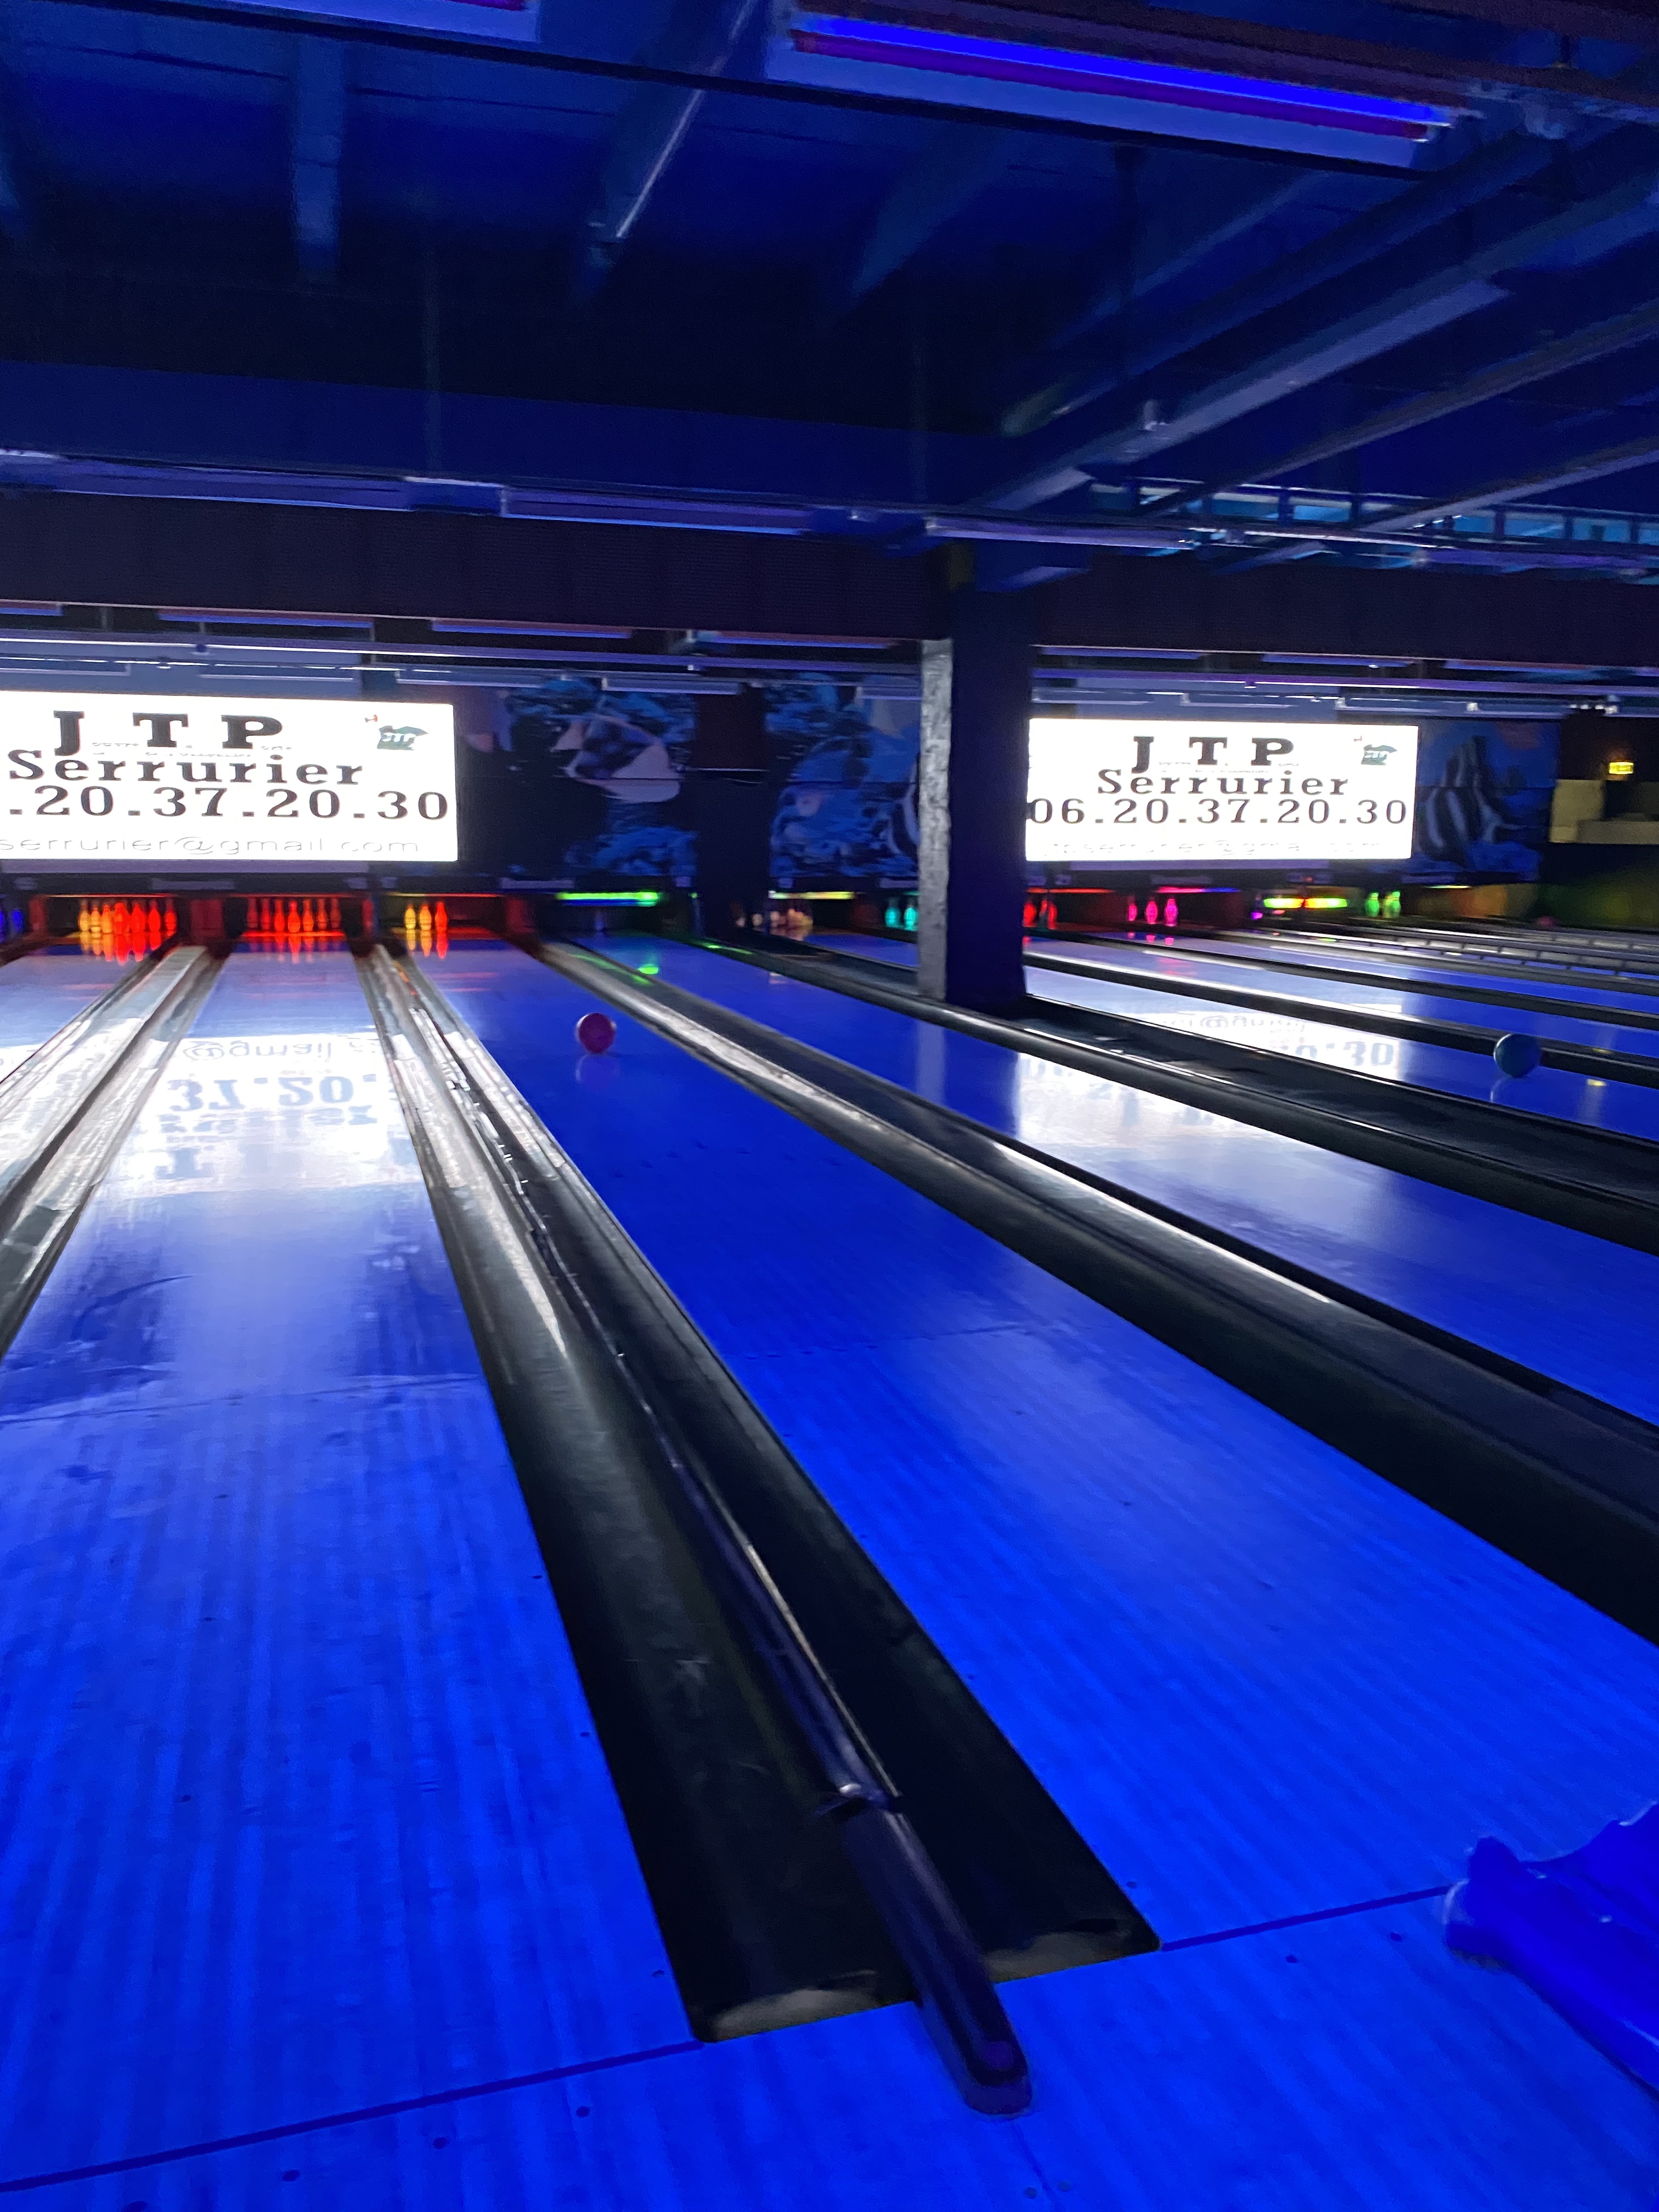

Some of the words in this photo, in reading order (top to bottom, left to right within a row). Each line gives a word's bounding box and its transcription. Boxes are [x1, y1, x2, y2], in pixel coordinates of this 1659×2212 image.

[8, 749, 363, 785] Serrurier
[1098, 769, 1348, 795] Serrurier
[9, 785, 448, 820] .20.37.20.30
[1028, 798, 1407, 825] 06.20.37.20.30
[0, 836, 419, 855] serrurier@gmailcom
